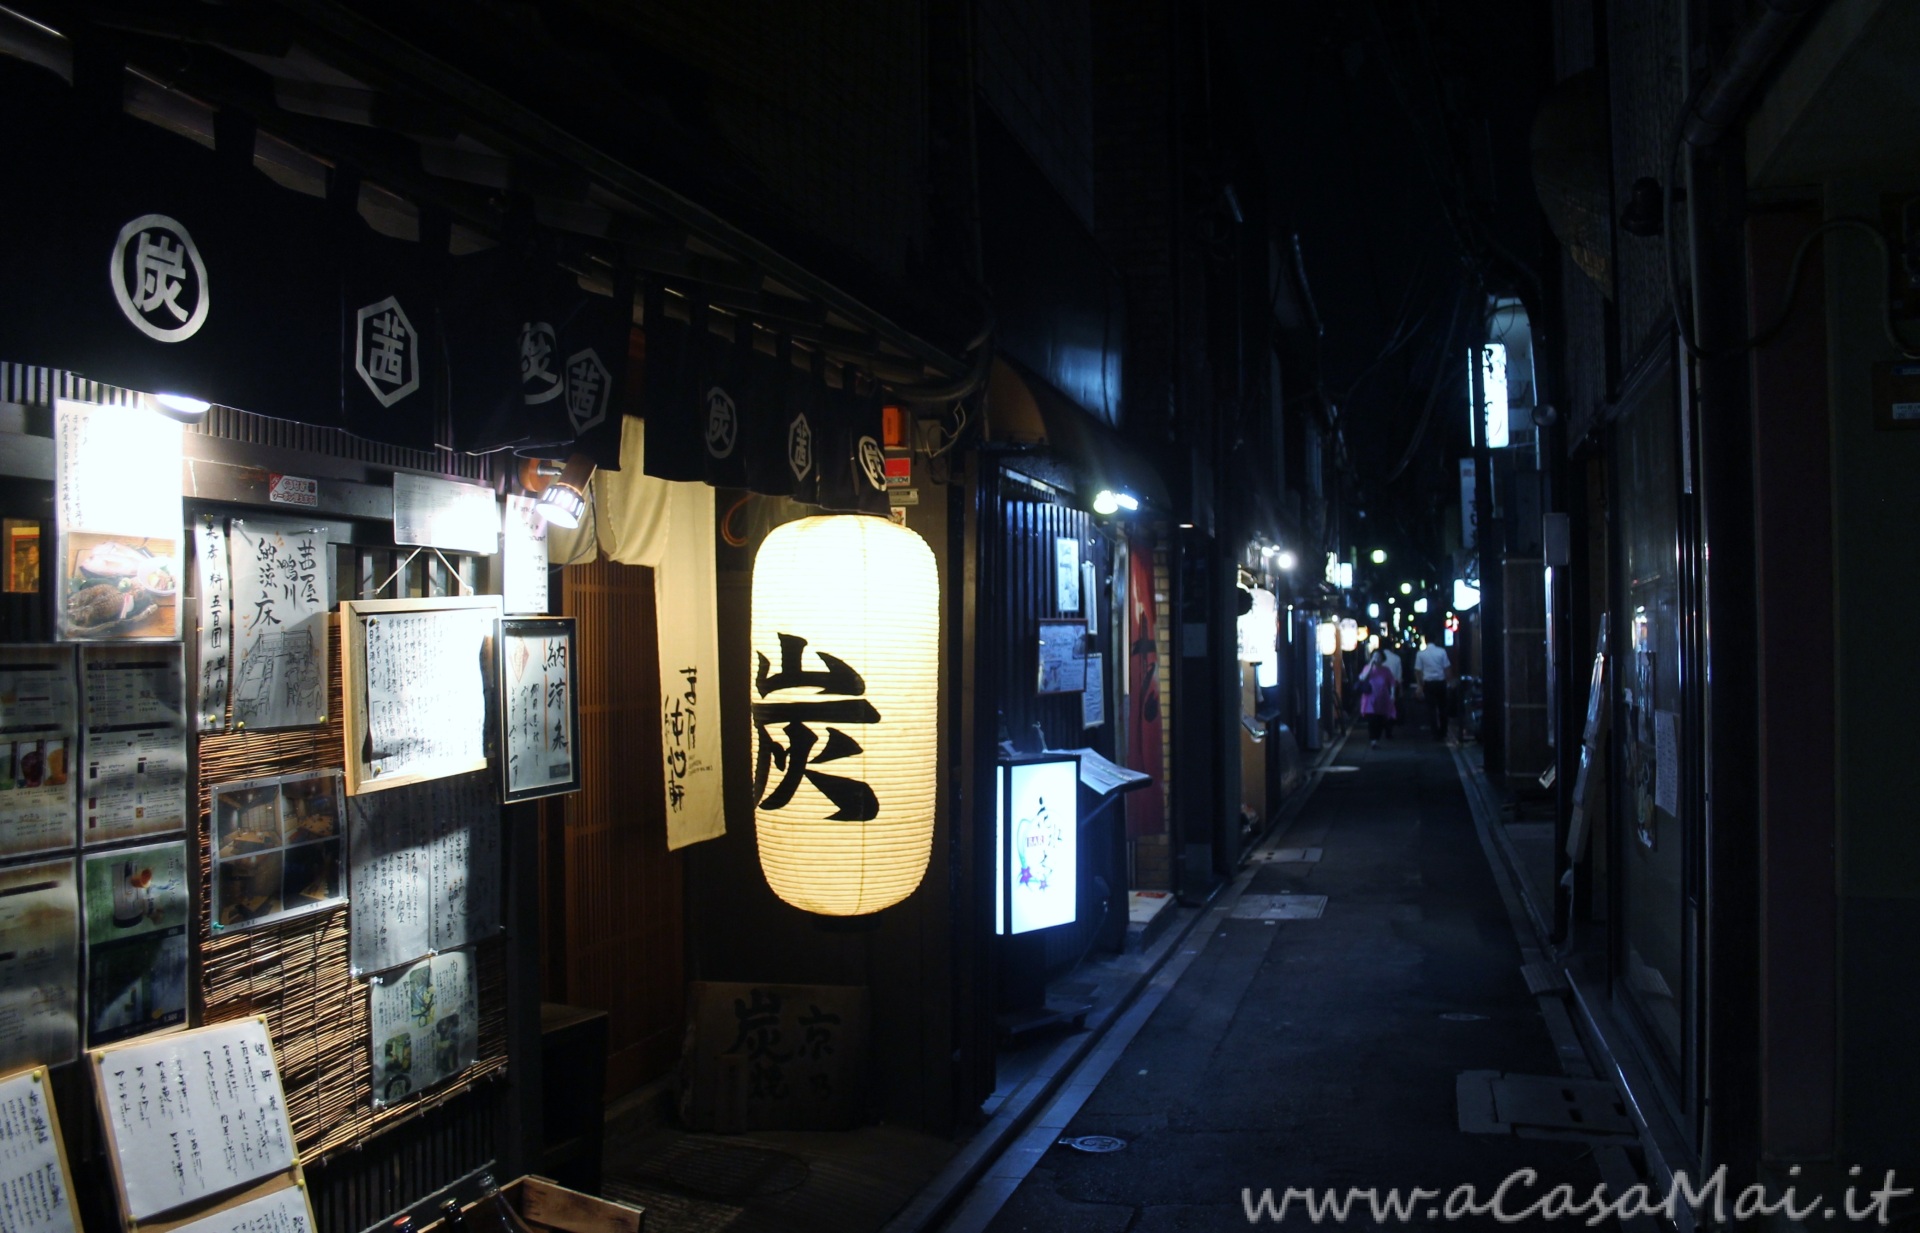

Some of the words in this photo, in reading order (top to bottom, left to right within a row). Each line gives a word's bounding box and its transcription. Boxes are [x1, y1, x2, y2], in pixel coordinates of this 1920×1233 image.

[132, 231, 189, 323] 炭
[369, 311, 406, 386] 茜
[571, 360, 601, 419] 茜
[709, 397, 731, 446] 炭
[297, 539, 319, 604] 茜屋
[752, 631, 882, 822] 炭
